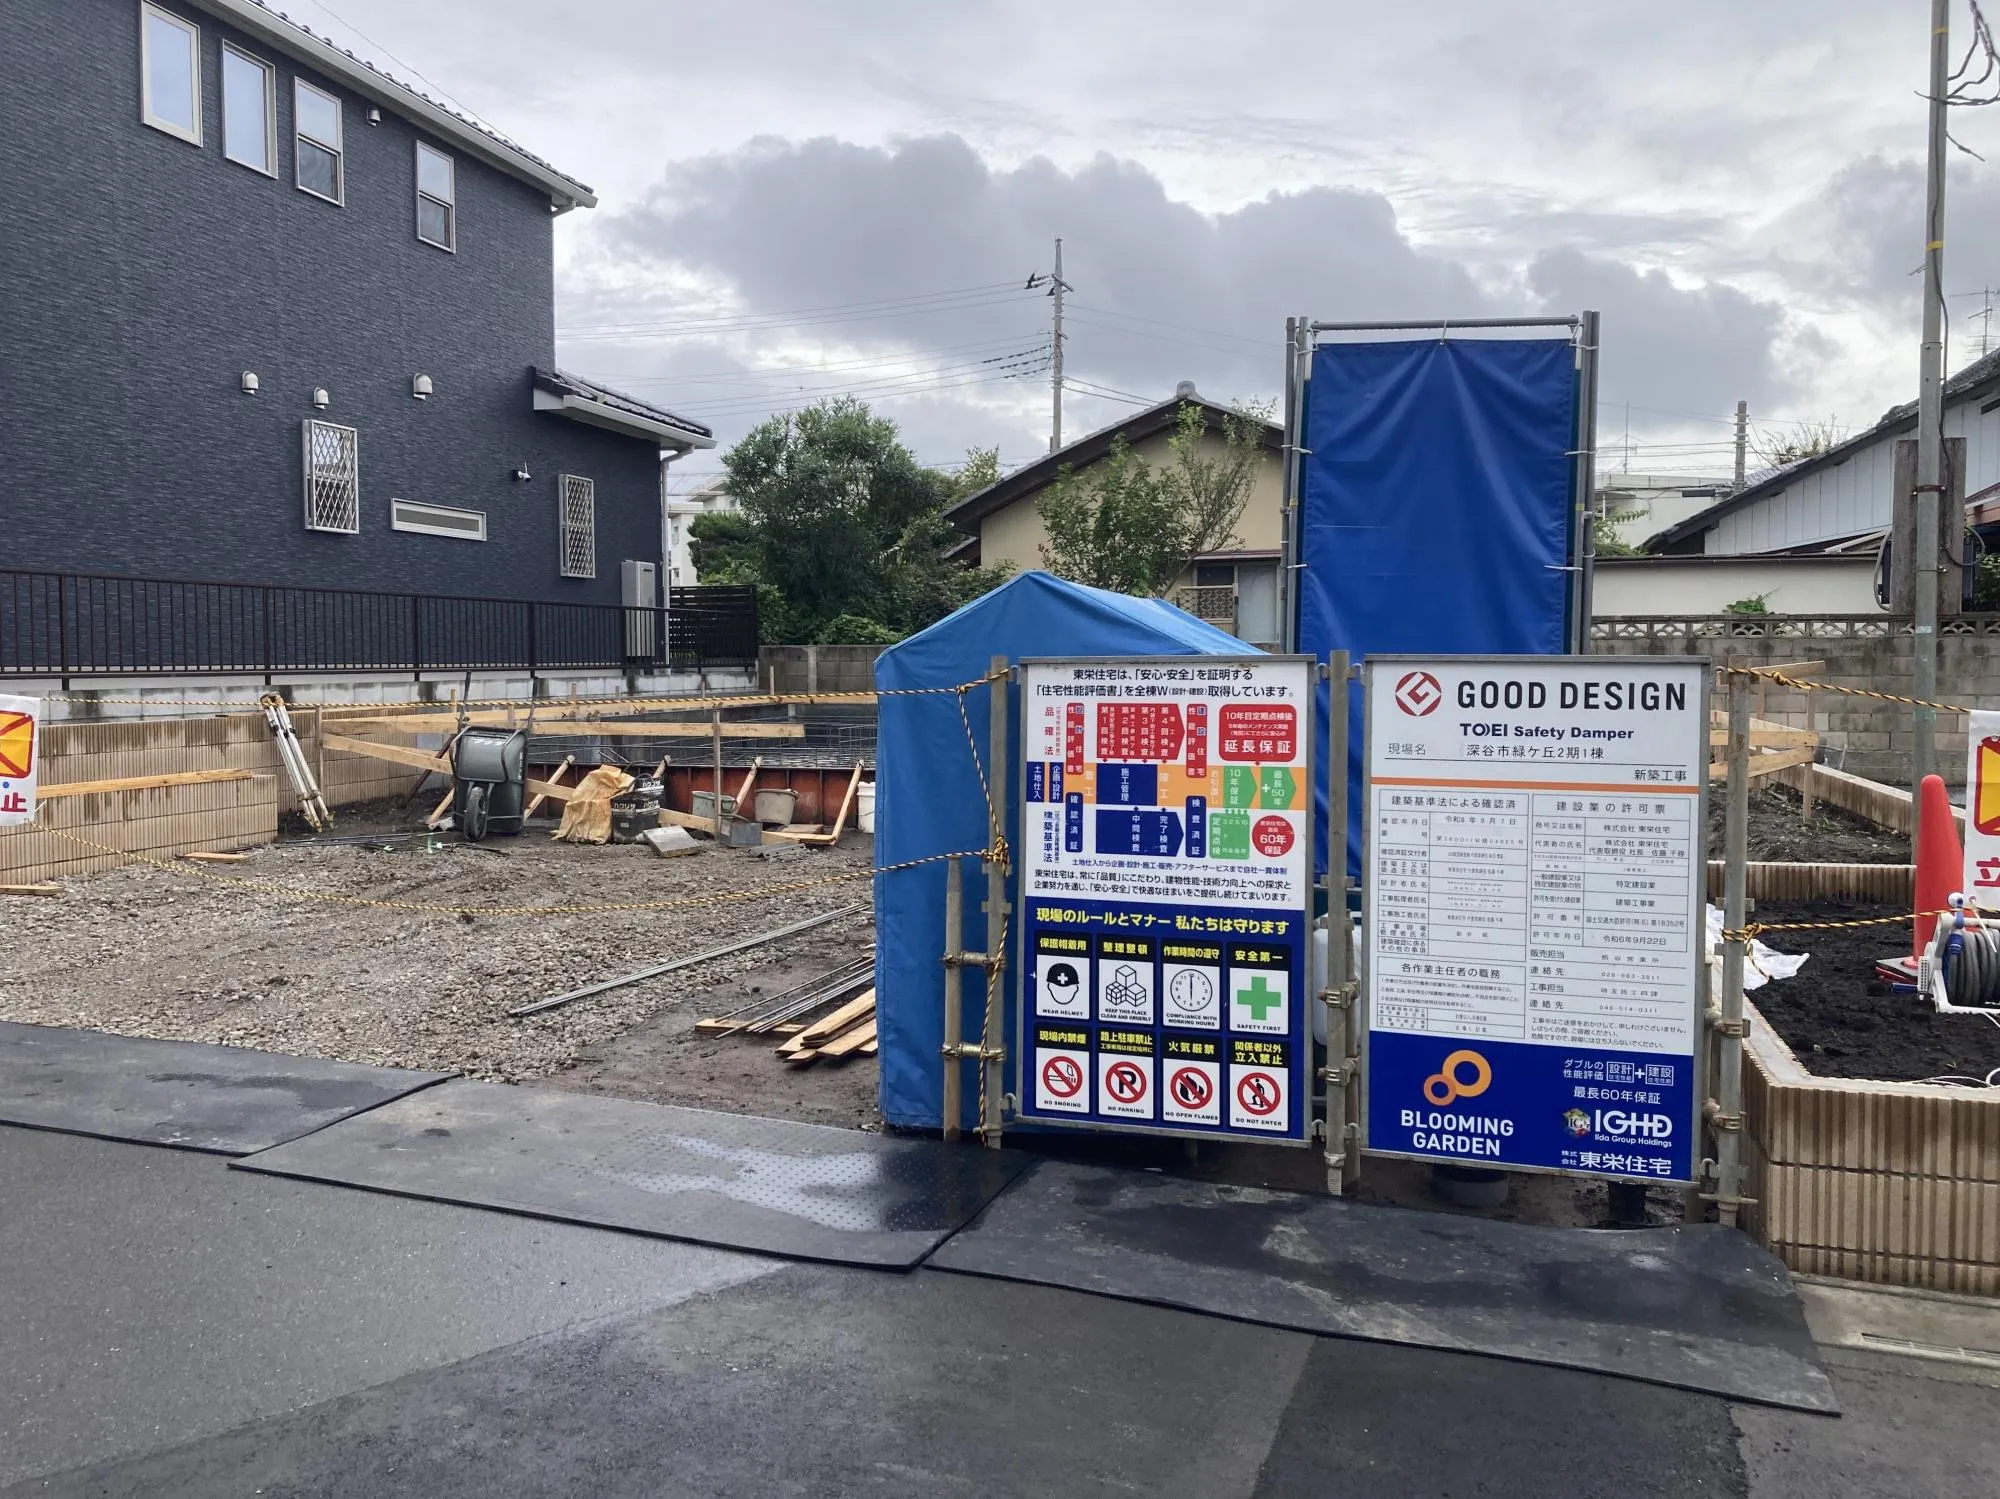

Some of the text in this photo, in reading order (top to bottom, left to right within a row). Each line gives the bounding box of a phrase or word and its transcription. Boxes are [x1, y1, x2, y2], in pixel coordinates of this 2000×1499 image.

[1457, 680, 1686, 711] GOOD DESIGN
[1044, 706, 1055, 756] 品確法
[1514, 726, 1566, 740] Safety
[1570, 727, 1635, 741] Damper
[1224, 739, 1292, 754] 延長保証
[1388, 743, 1426, 755] 現場名
[1033, 765, 1041, 800] 土地仕入
[1633, 769, 1687, 782] 新築工事
[1121, 768, 1130, 802] 施工管理
[1, 792, 28, 813] 止
[1391, 795, 1516, 809] 建築基準法による確認済
[1556, 801, 1666, 815] 建設業の許可票
[1070, 795, 1079, 850] 確認済証
[1191, 799, 1201, 855] 検査済証
[1604, 824, 1635, 833] 株式会社
[1638, 825, 1670, 834] 東栄住宅
[1131, 814, 1141, 852] 中間検査
[1159, 815, 1169, 853] 完了検査
[1259, 834, 1287, 844] 60年
[1264, 846, 1282, 855] 保証
[1036, 907, 1290, 935] 現場のルールとマナー 私たちは守ります
[1040, 937, 1087, 951] 保護帽着用
[1103, 941, 1148, 955] 整理整頓
[1163, 946, 1220, 960] 作業時間の遵守
[1235, 950, 1283, 963] 安全第一
[1530, 950, 1565, 959] 販売担当
[1401, 963, 1501, 980] 各作業主任者の職務
[1530, 966, 1565, 976] 連絡先
[1530, 983, 1564, 993] 工事担当
[1530, 1000, 1564, 1010] 連絡先
[1039, 1030, 1087, 1044] 現場内禁煙
[1100, 1031, 1153, 1045] 路上駐車禁止
[1168, 1041, 1215, 1055] 火気厳禁
[1234, 1041, 1281, 1053] 関係者以外
[1235, 1052, 1283, 1065] 立入禁止
[1564, 1059, 1604, 1070] ダブルの
[1562, 1070, 1604, 1081] 性能評価
[1609, 1063, 1632, 1075] 設計
[1648, 1066, 1672, 1078] 建設
[1573, 1086, 1661, 1105] 最長60年保証
[1401, 1109, 1514, 1137] BLOOMING
[1594, 1109, 1673, 1138] IGHD
[1412, 1131, 1500, 1157] GARDEN
[1611, 1135, 1637, 1145] Group
[1638, 1136, 1673, 1149] Holdings
[1579, 1151, 1672, 1175] 東栄住宅
